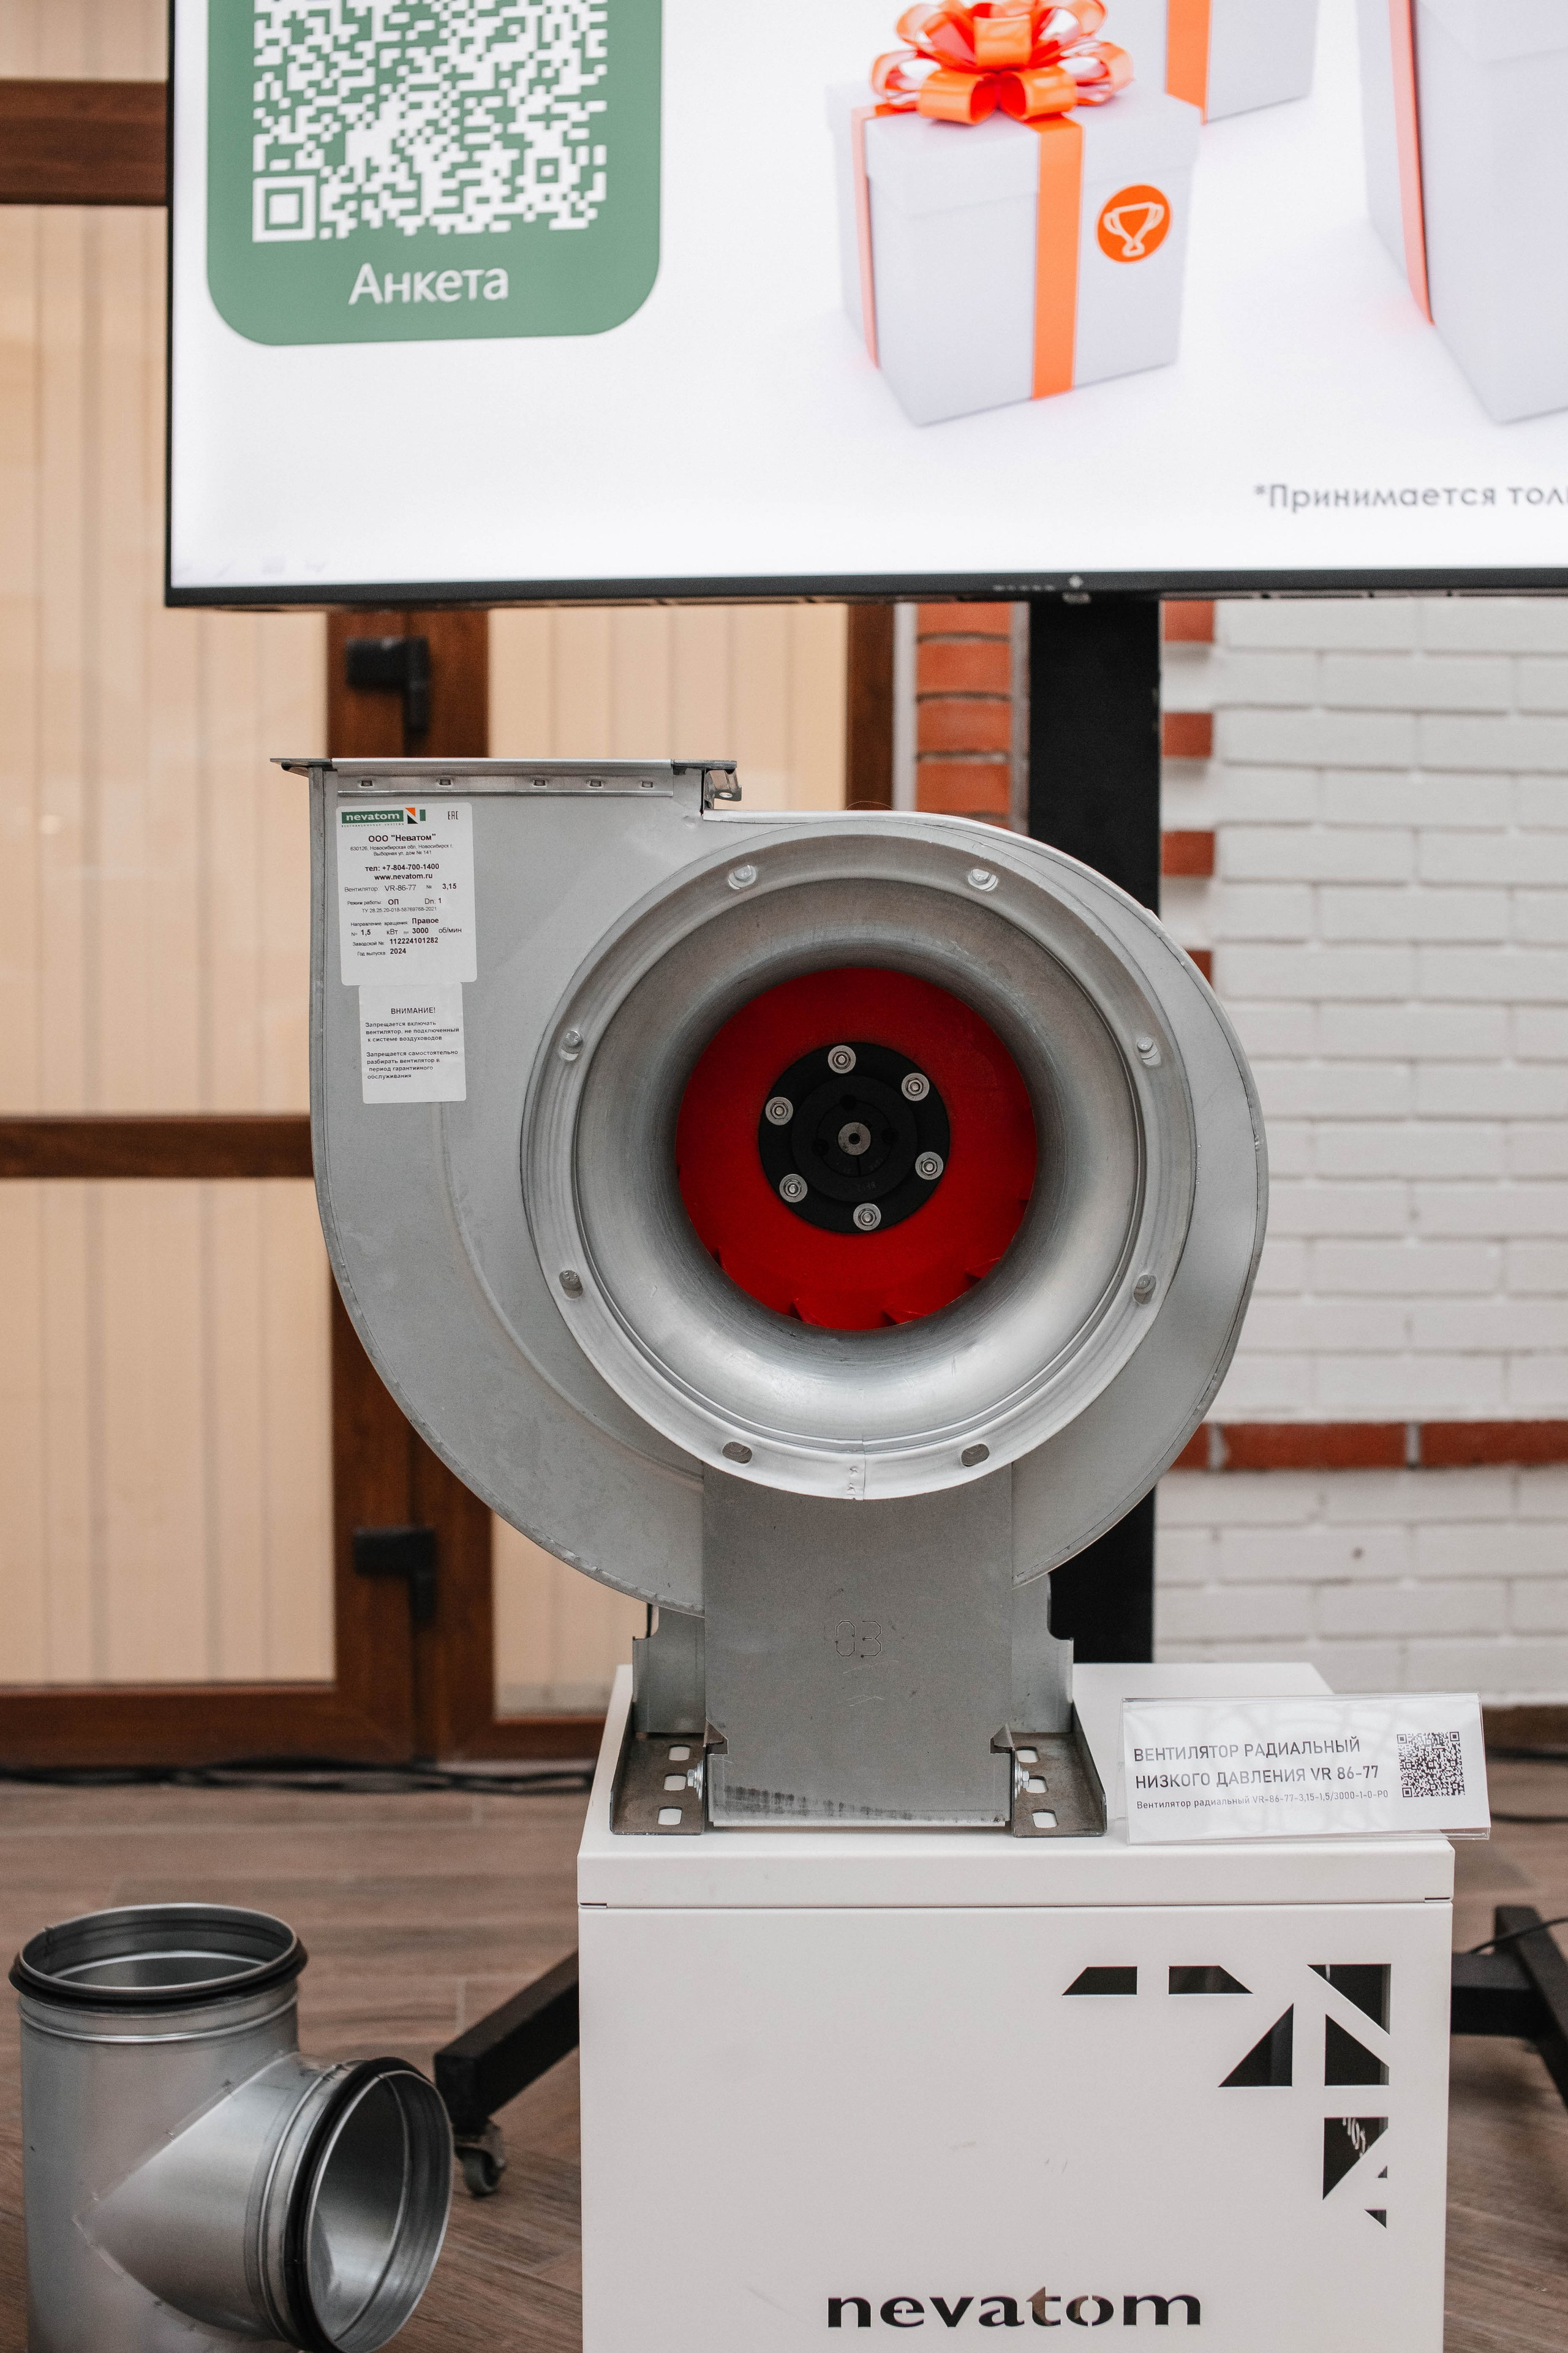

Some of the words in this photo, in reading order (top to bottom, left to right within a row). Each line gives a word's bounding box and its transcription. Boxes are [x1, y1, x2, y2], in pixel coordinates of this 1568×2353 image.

[348, 262, 508, 305] Анкета
[1507, 486, 1568, 506] тол
[1134, 1745, 1238, 1761] ВЕНТИЛЯТОР
[1245, 1736, 1360, 1758] РАДИАЛЬНЫЙ
[1136, 1773, 1210, 1789] НИЗКОГО
[1216, 1768, 1305, 1788] ДАВЛЕНИЯ
[1311, 1767, 1332, 1780] VR
[1337, 1766, 1378, 1779] 86-77
[1194, 1796, 1250, 1808] радиальный
[828, 2286, 1200, 2328] nevatom
